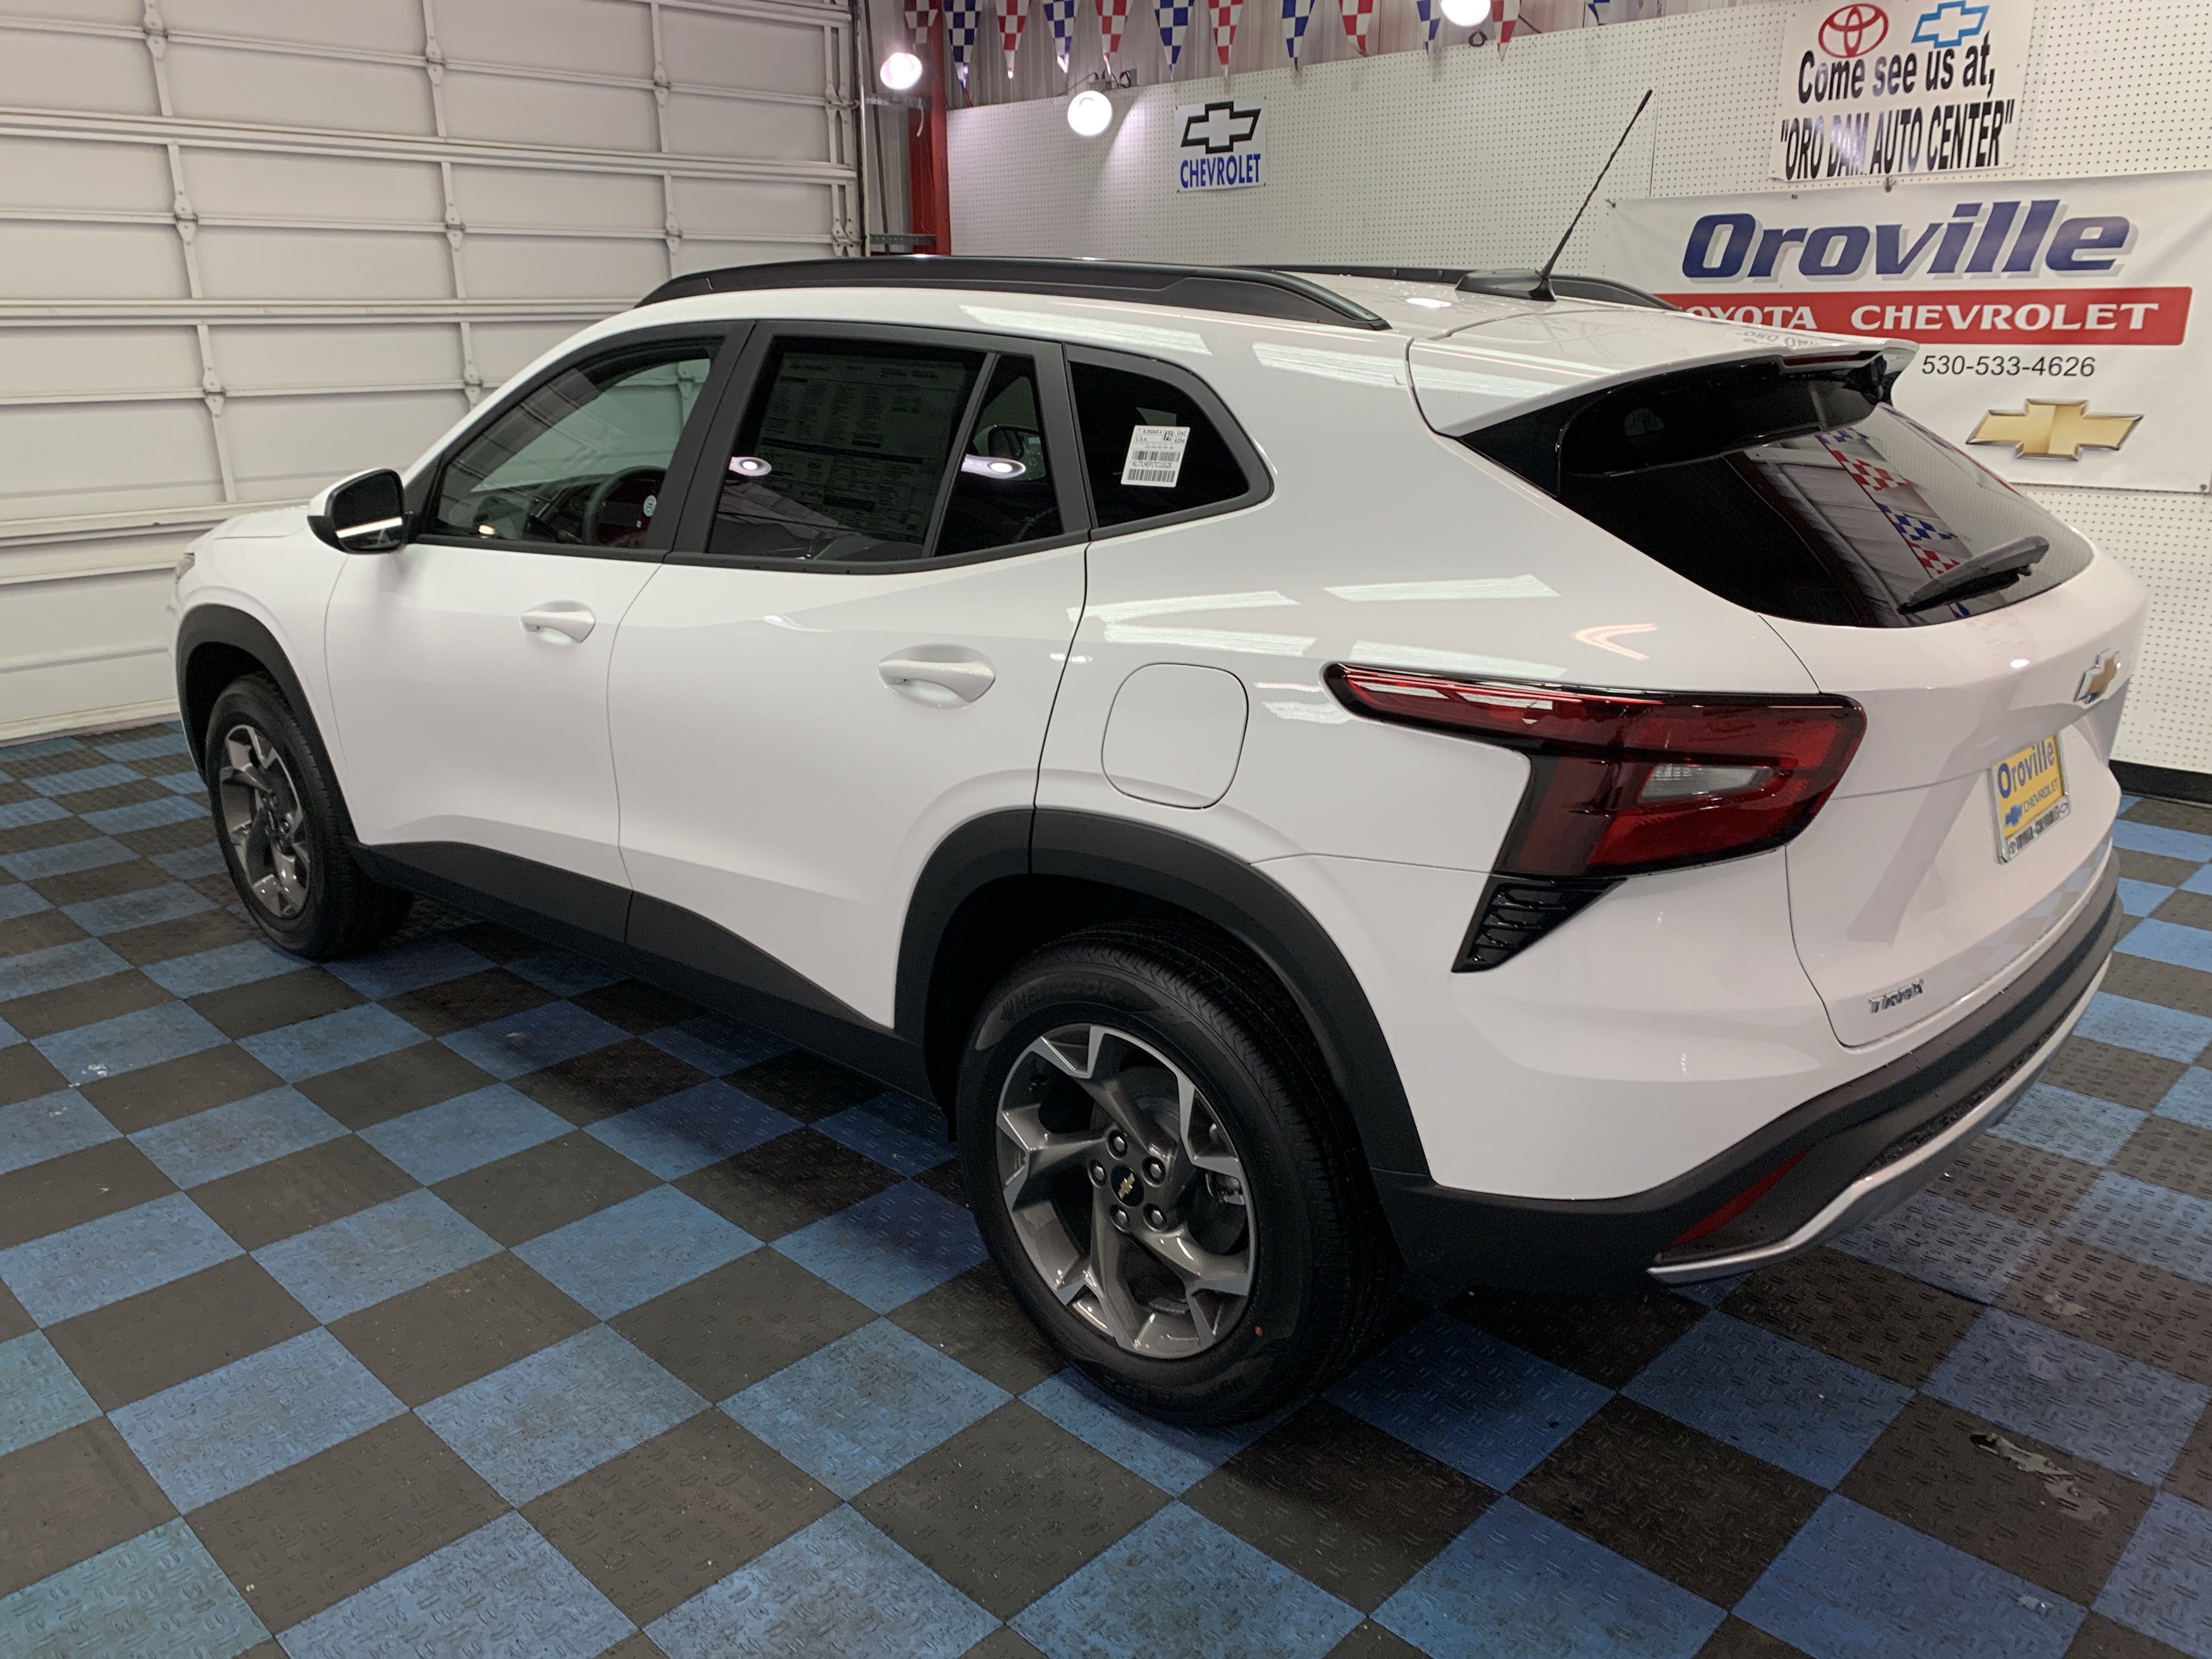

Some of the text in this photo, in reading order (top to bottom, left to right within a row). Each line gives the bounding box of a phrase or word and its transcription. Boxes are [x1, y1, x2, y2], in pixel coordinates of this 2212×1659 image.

[1798, 30, 1995, 104] Come see us at,
[1781, 115, 1825, 180] "ORO
[1870, 107, 1923, 175] AUTO
[1927, 99, 2015, 172] CENTER"
[1181, 154, 1261, 188] CHEVROLET
[1682, 200, 2136, 282] Oroville
[1850, 303, 2159, 331] CHEVROLET
[1922, 356, 2096, 377] 530-533-4626
[1997, 741, 2055, 799] Oroville
[2023, 778, 2058, 813] CHEVROLET
